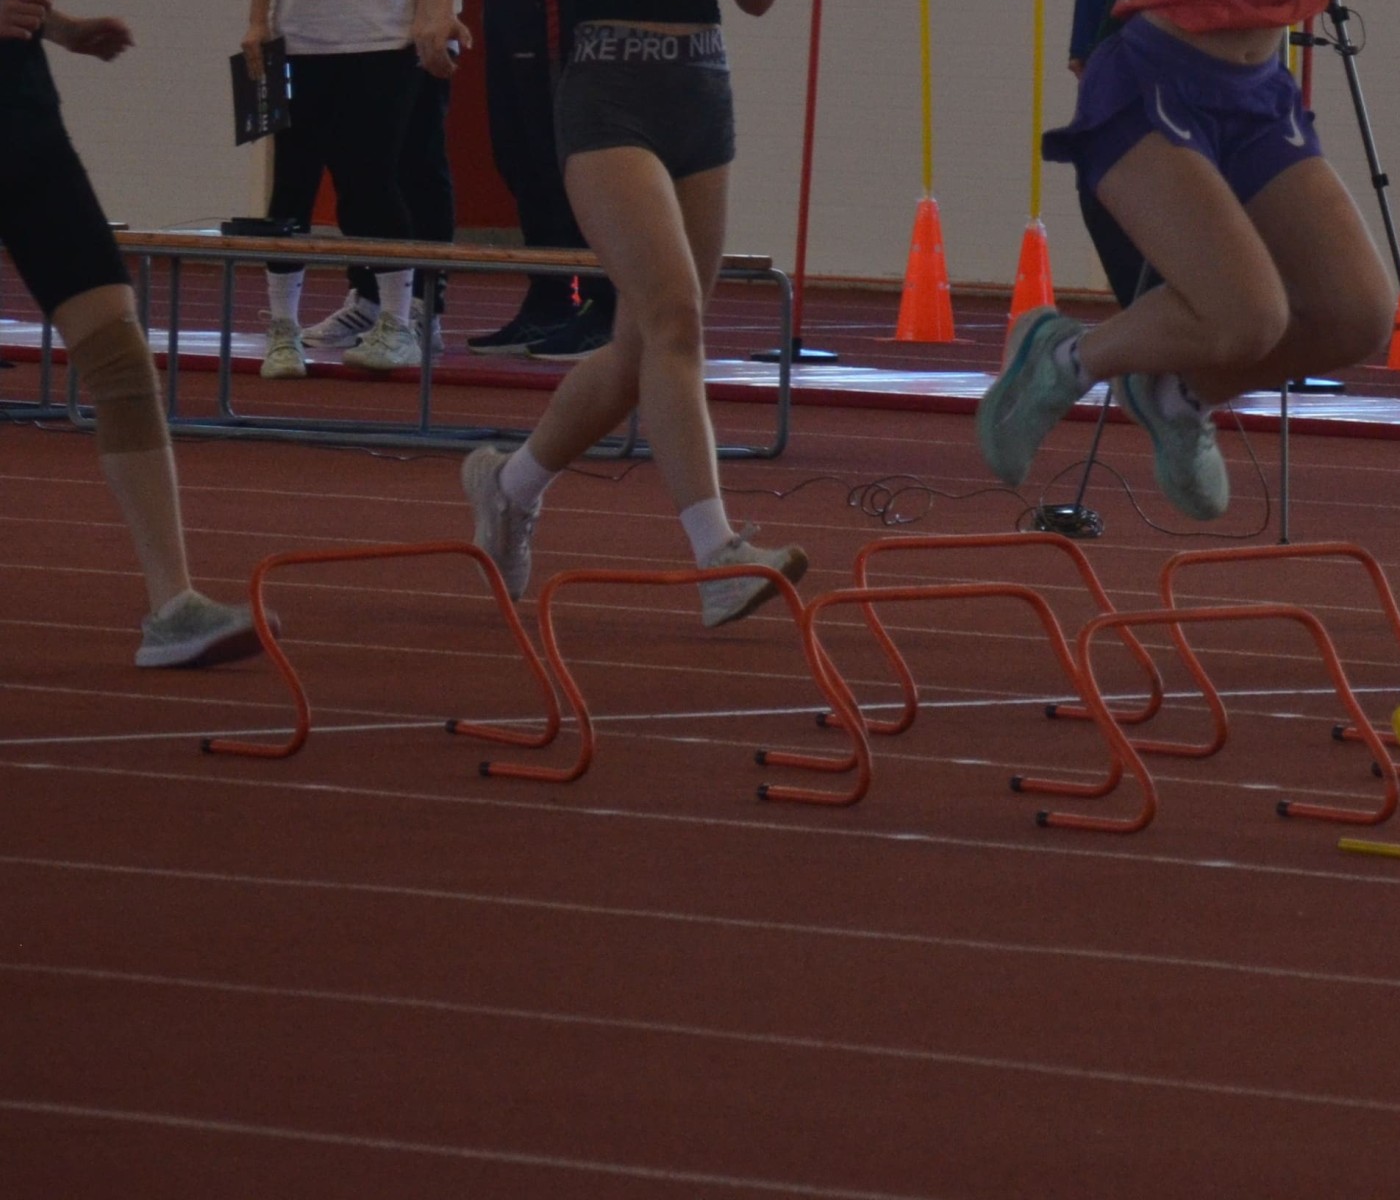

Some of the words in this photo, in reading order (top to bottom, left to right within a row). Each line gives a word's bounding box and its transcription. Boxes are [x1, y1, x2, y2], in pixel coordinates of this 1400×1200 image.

[574, 38, 618, 62] IKE
[623, 37, 678, 61] PRO
[689, 30, 724, 57] NIK
